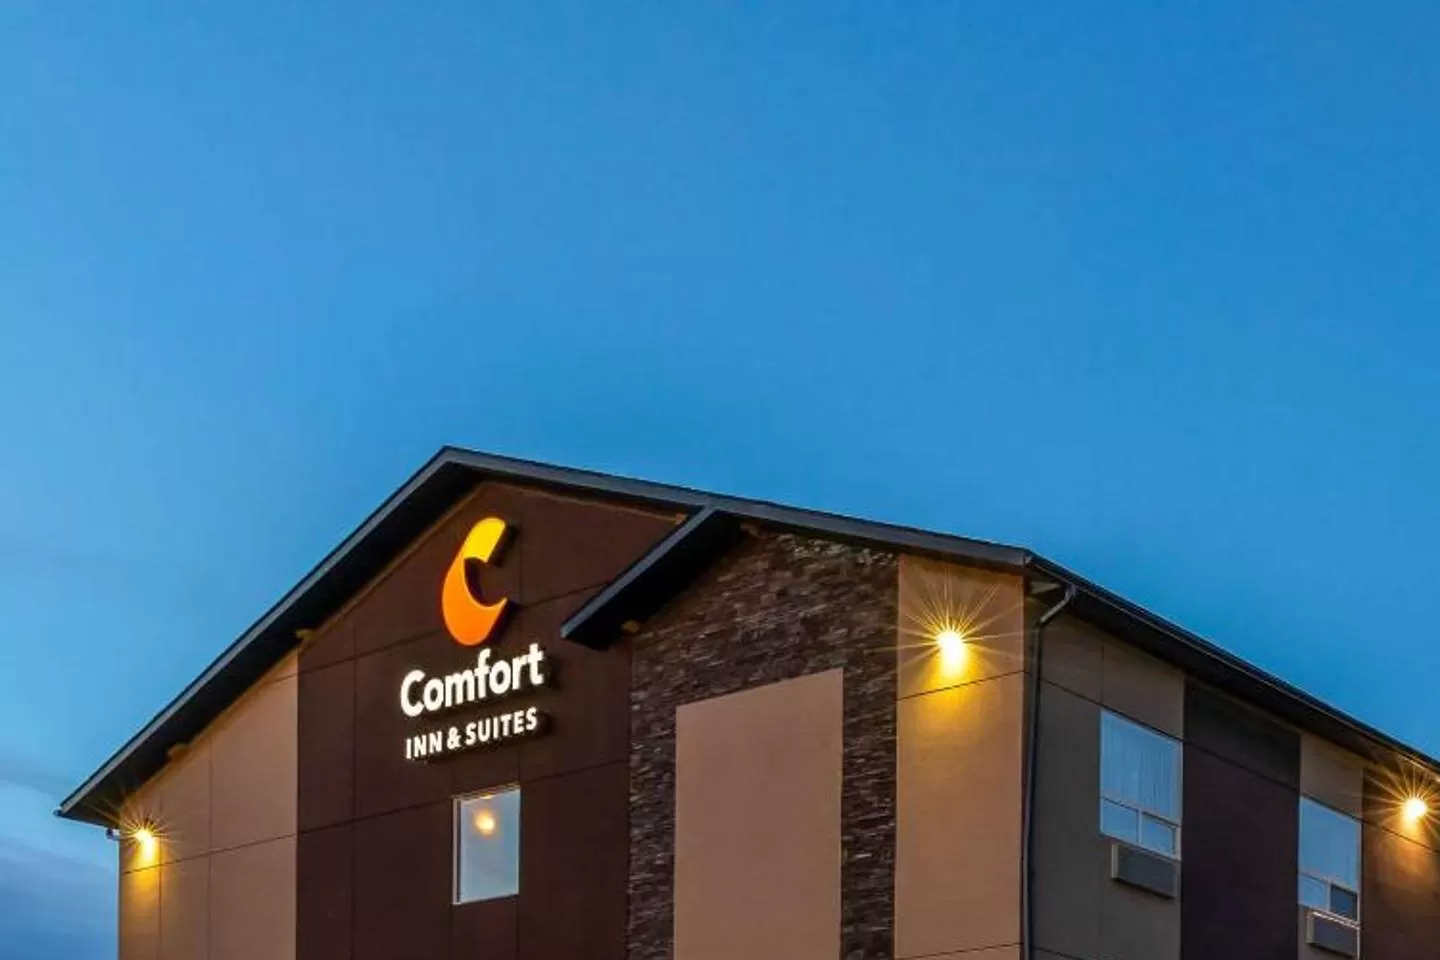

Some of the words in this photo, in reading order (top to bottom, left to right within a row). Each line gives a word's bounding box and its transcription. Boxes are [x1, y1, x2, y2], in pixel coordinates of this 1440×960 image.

[400, 642, 545, 717] Comfort
[405, 731, 443, 759] INN
[447, 727, 462, 750] &
[465, 706, 538, 746] SUITES
